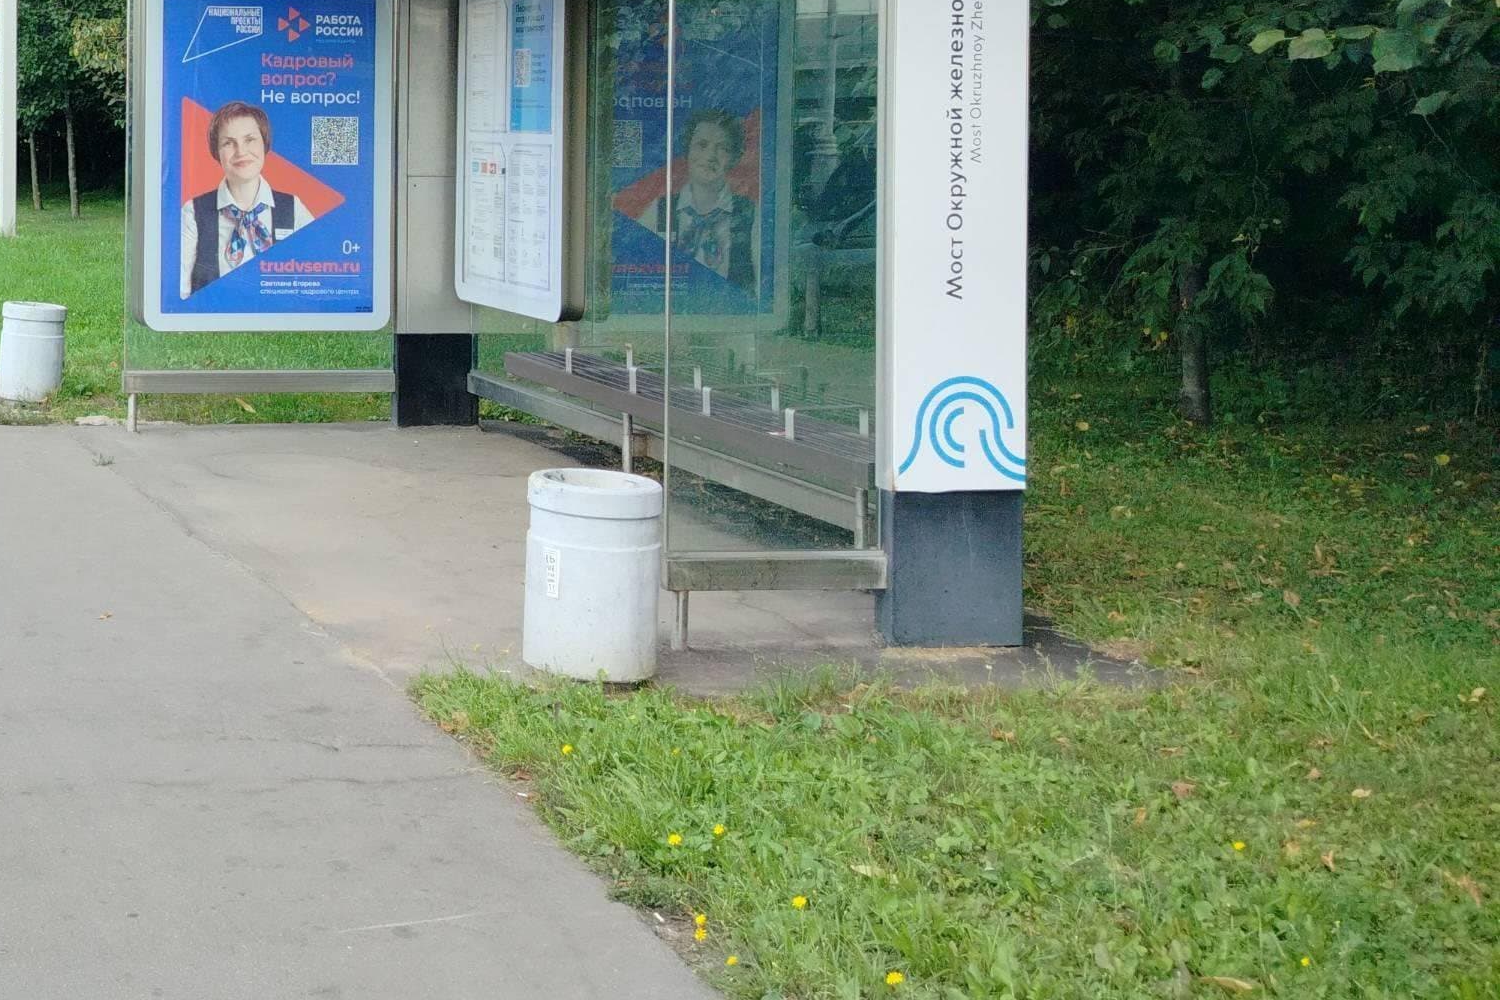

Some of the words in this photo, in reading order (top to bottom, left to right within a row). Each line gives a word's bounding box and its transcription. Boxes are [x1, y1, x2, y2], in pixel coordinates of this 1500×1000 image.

[208, 8, 261, 17] НАЦИОНАЛЬНЫЕ
[315, 15, 361, 25] РАБОТА
[231, 16, 261, 25] ПРОЕКТЫ
[236, 25, 261, 34] РОССИИ
[315, 27, 363, 37] РОССИИ
[261, 53, 354, 70] Кадровый
[261, 72, 337, 88] вопрос?
[970, 34, 986, 120] Okruzhnoy
[261, 89, 286, 104] Не
[291, 90, 360, 107] вопрос!
[970, 124, 982, 164] Most
[946, 107, 967, 231] Окружной
[342, 240, 360, 254] 0+
[260, 259, 360, 273] trudvsem.ru
[946, 237, 964, 300] Мост
